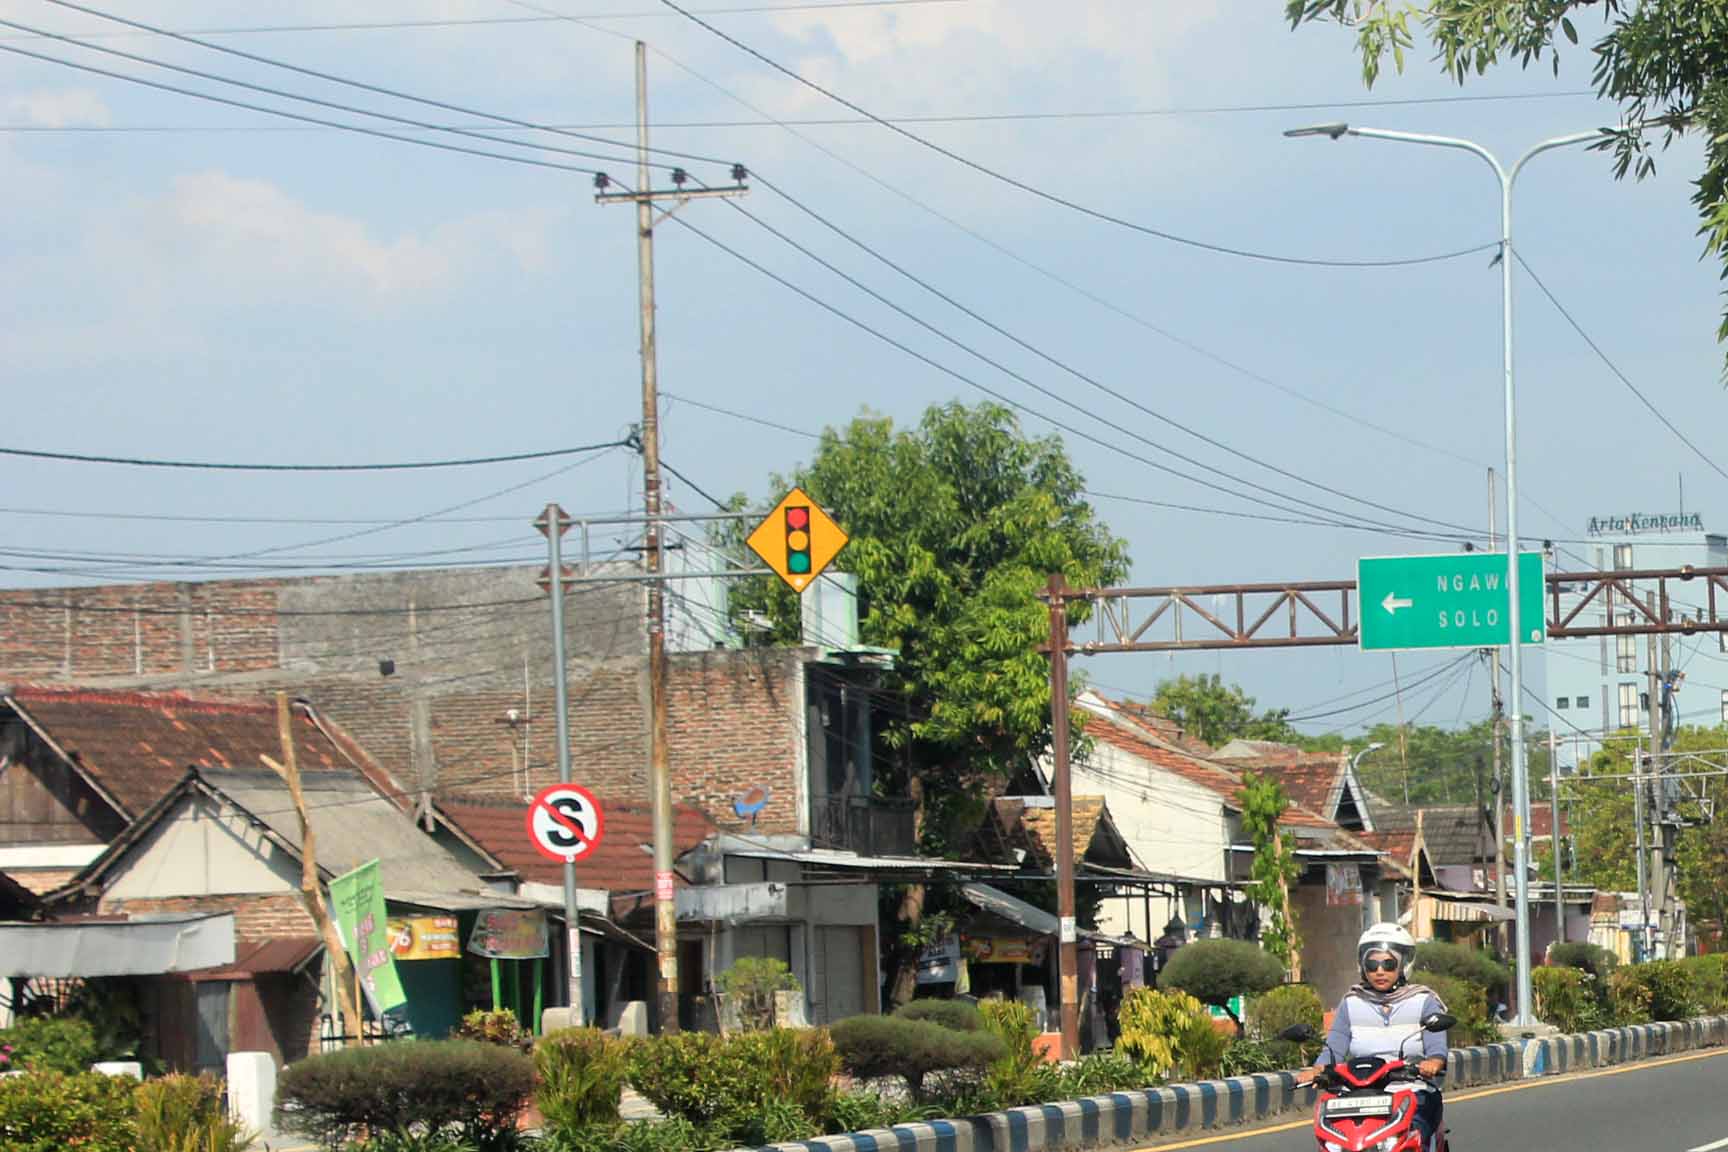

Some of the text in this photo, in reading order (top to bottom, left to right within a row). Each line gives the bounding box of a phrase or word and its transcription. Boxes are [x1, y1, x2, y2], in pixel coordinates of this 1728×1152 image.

[1589, 516, 1624, 531] Arta
[1438, 608, 1499, 628] SOLO
[546, 797, 585, 847] S
